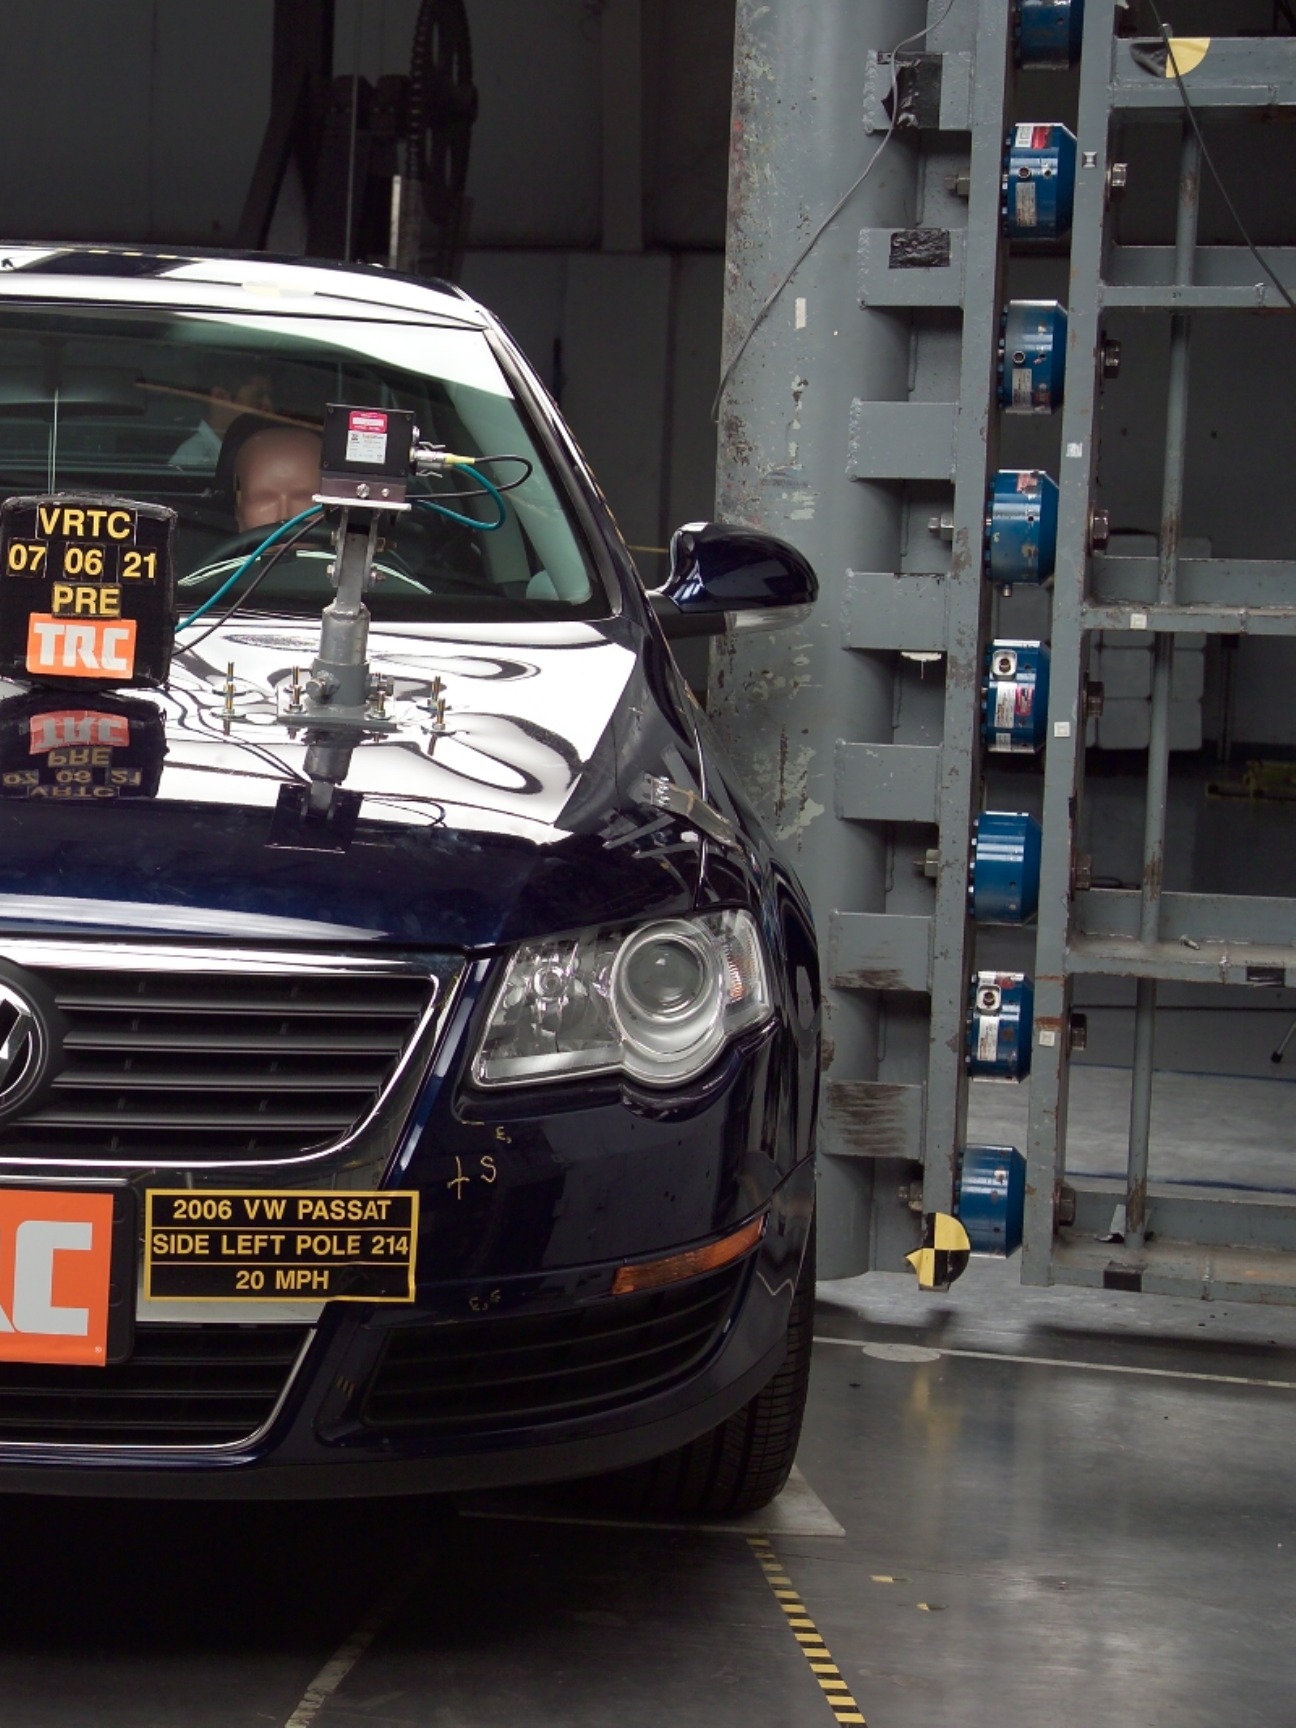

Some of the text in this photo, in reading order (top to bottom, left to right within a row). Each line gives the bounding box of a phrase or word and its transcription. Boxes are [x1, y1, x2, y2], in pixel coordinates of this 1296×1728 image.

[39, 507, 131, 539] VRTC
[8, 543, 157, 579] 07 06 21
[53, 584, 120, 615] PRE
[33, 622, 130, 671] TRC
[172, 1199, 392, 1221] 2006 VW PASSAT
[153, 1233, 409, 1256] SIDE LEFT POLE 214
[235, 1270, 330, 1290] 20 MPH
